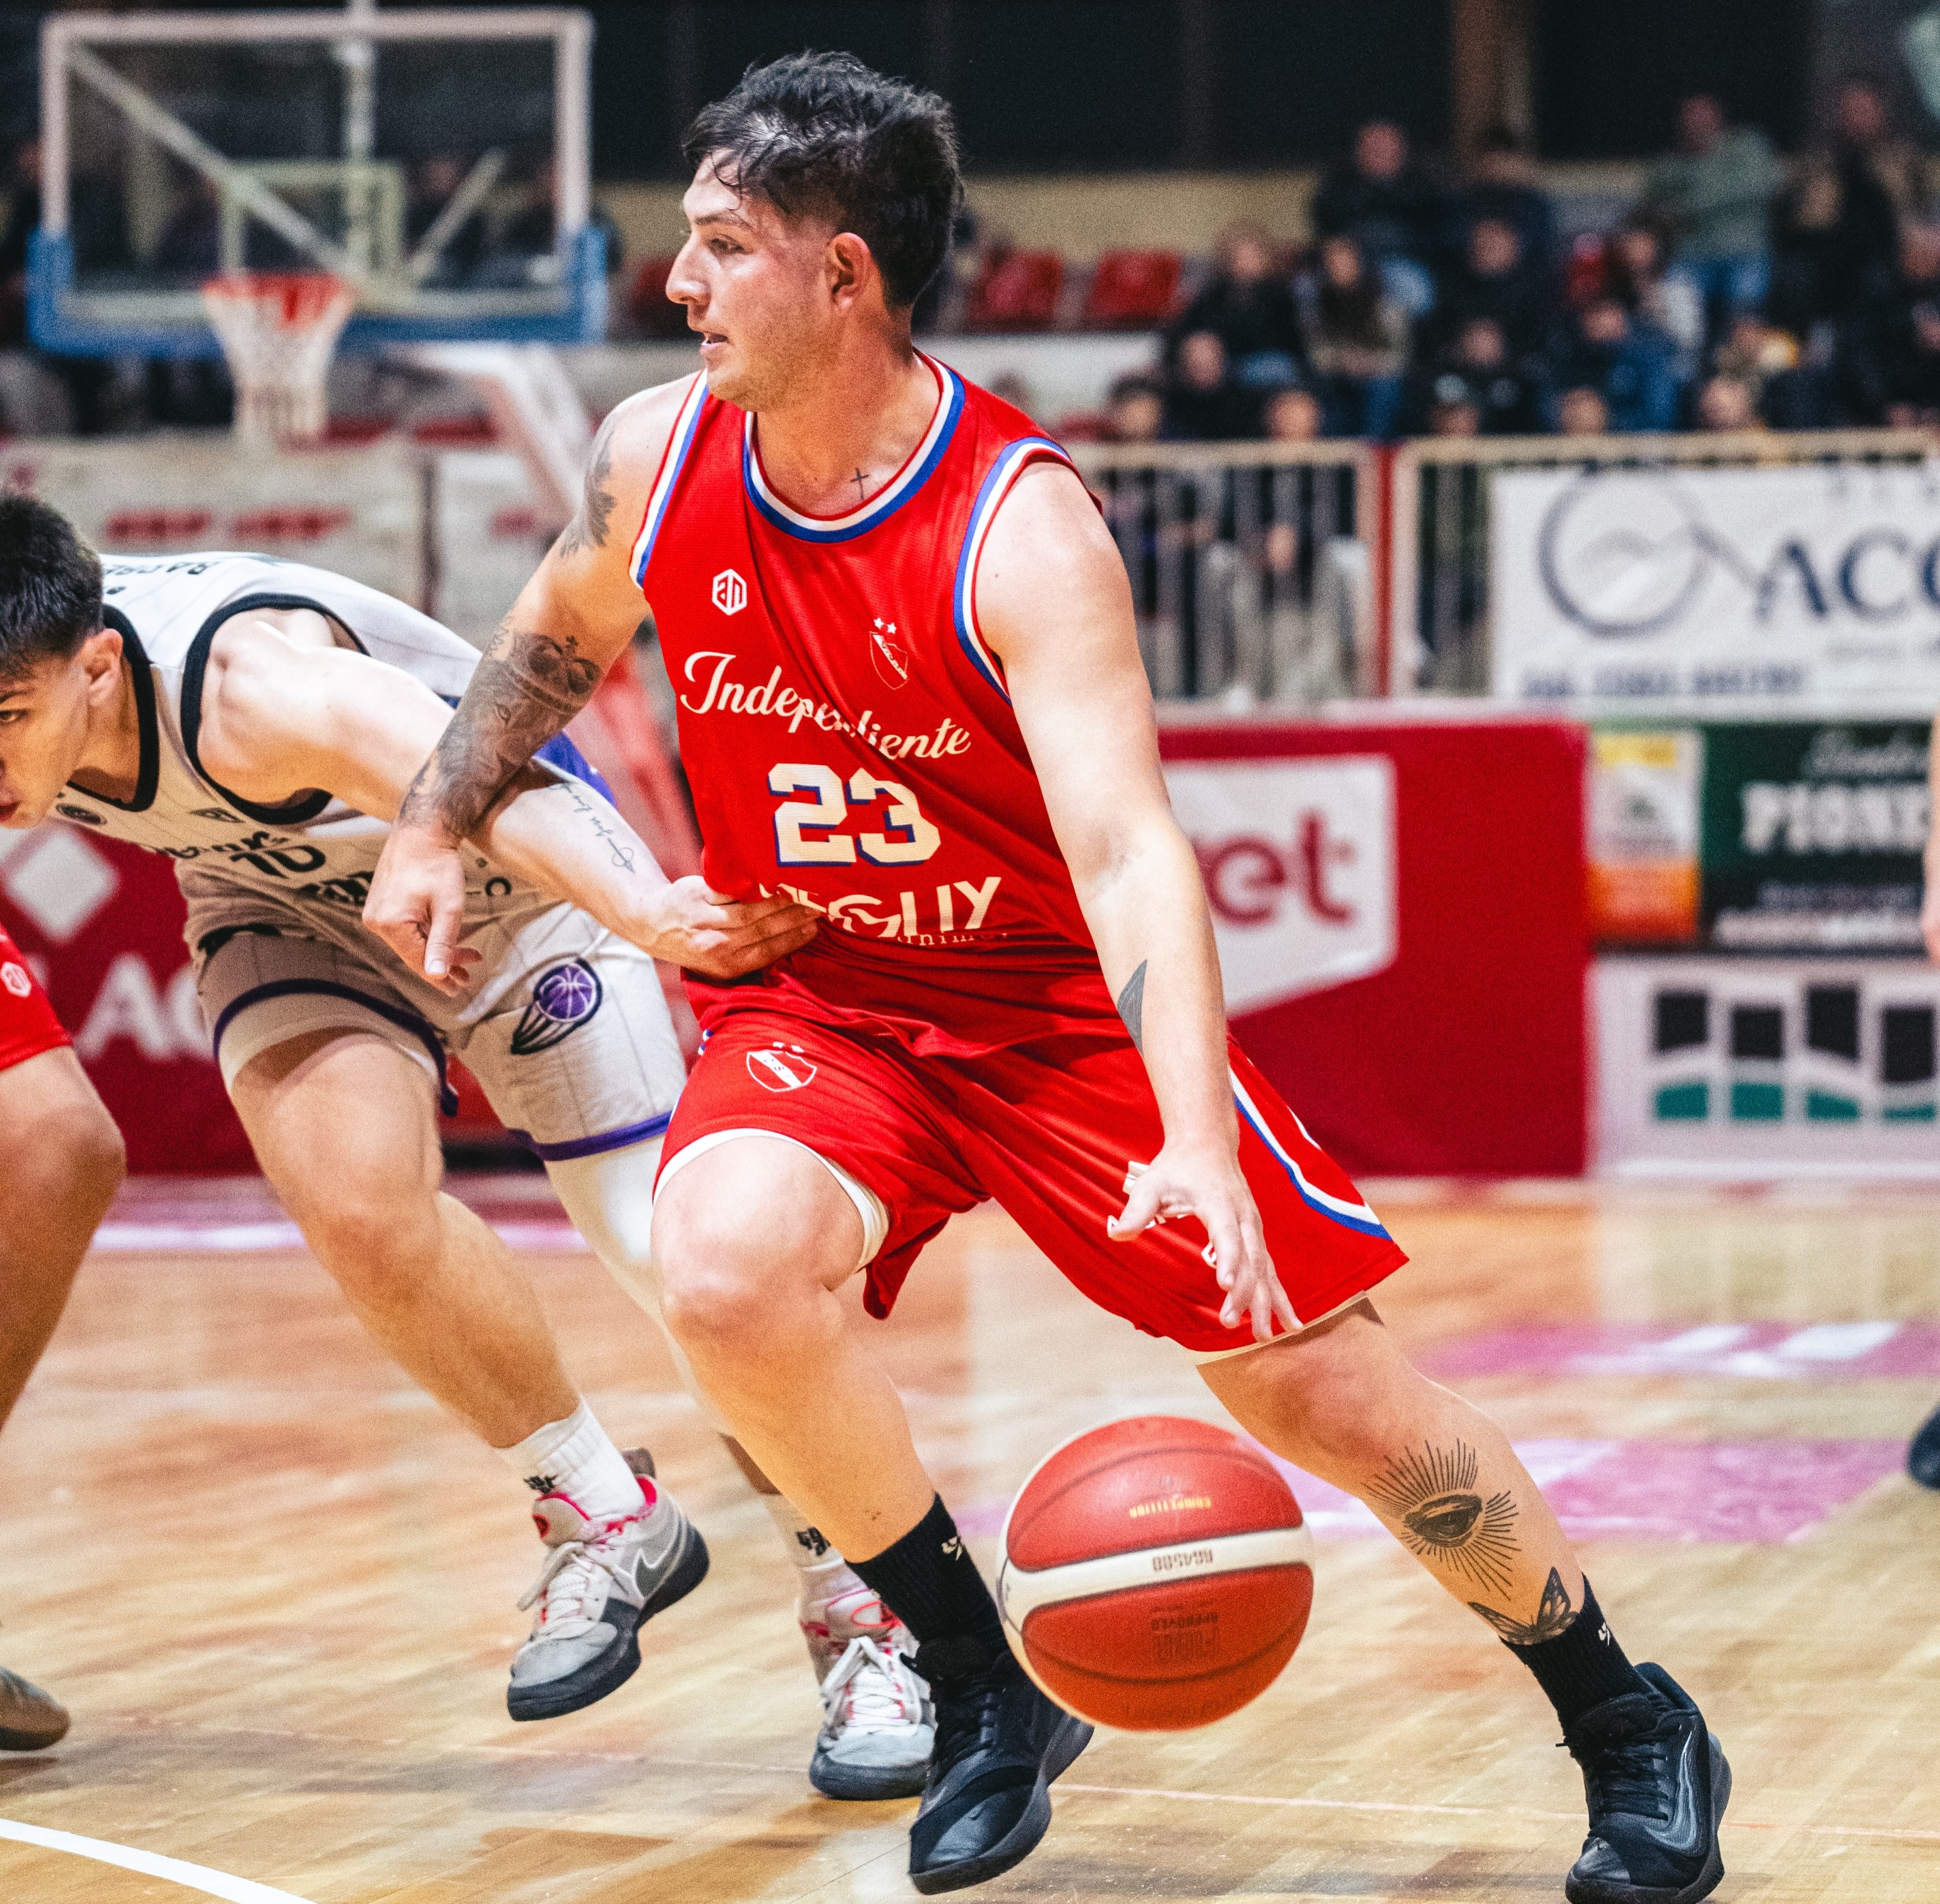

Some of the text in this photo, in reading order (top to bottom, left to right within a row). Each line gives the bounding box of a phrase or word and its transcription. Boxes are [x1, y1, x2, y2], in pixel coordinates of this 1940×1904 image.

[680, 650, 972, 760] Indepediente
[767, 762, 942, 868] 23
[1192, 805, 1361, 928] et
